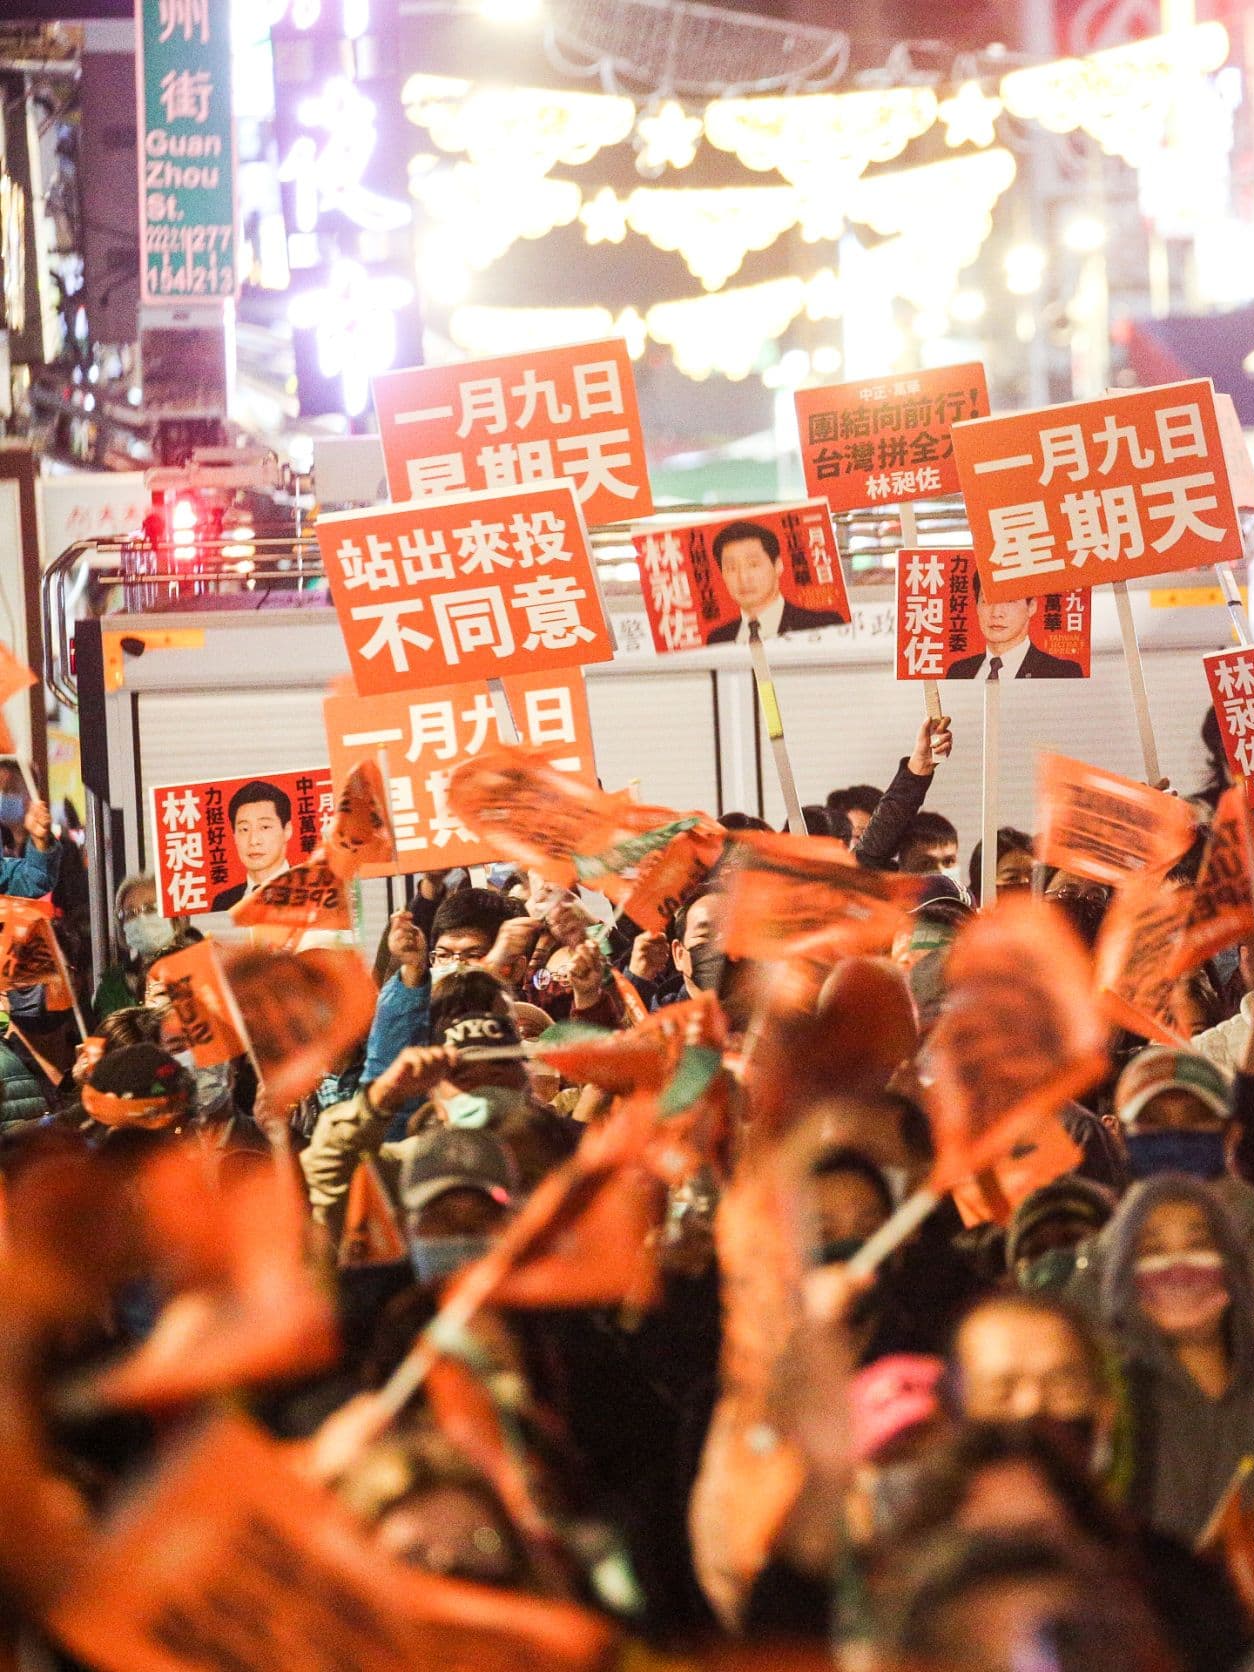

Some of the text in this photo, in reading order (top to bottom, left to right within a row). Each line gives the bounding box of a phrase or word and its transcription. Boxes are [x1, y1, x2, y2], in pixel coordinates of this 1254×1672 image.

[146, 129, 221, 157] Guan
[147, 160, 220, 190] Zhou
[147, 192, 185, 221] St.
[395, 360, 624, 438] 一月九日
[406, 428, 640, 504] 星期天
[866, 467, 942, 500] 林昶佐
[973, 403, 1208, 487] 一月九日
[336, 510, 575, 590] 站出來投
[988, 471, 1227, 582] 星期天
[350, 574, 597, 673] 不同意
[904, 554, 945, 676] 林昶佐
[949, 554, 969, 652] 力挺好立委
[1065, 587, 1085, 633] 九日
[342, 686, 577, 763] 一月九日
[162, 789, 209, 912] 林昶佐
[204, 787, 229, 885] 力挺好立委
[295, 776, 317, 854] 中正萬華
[443, 1018, 504, 1045] NYC
